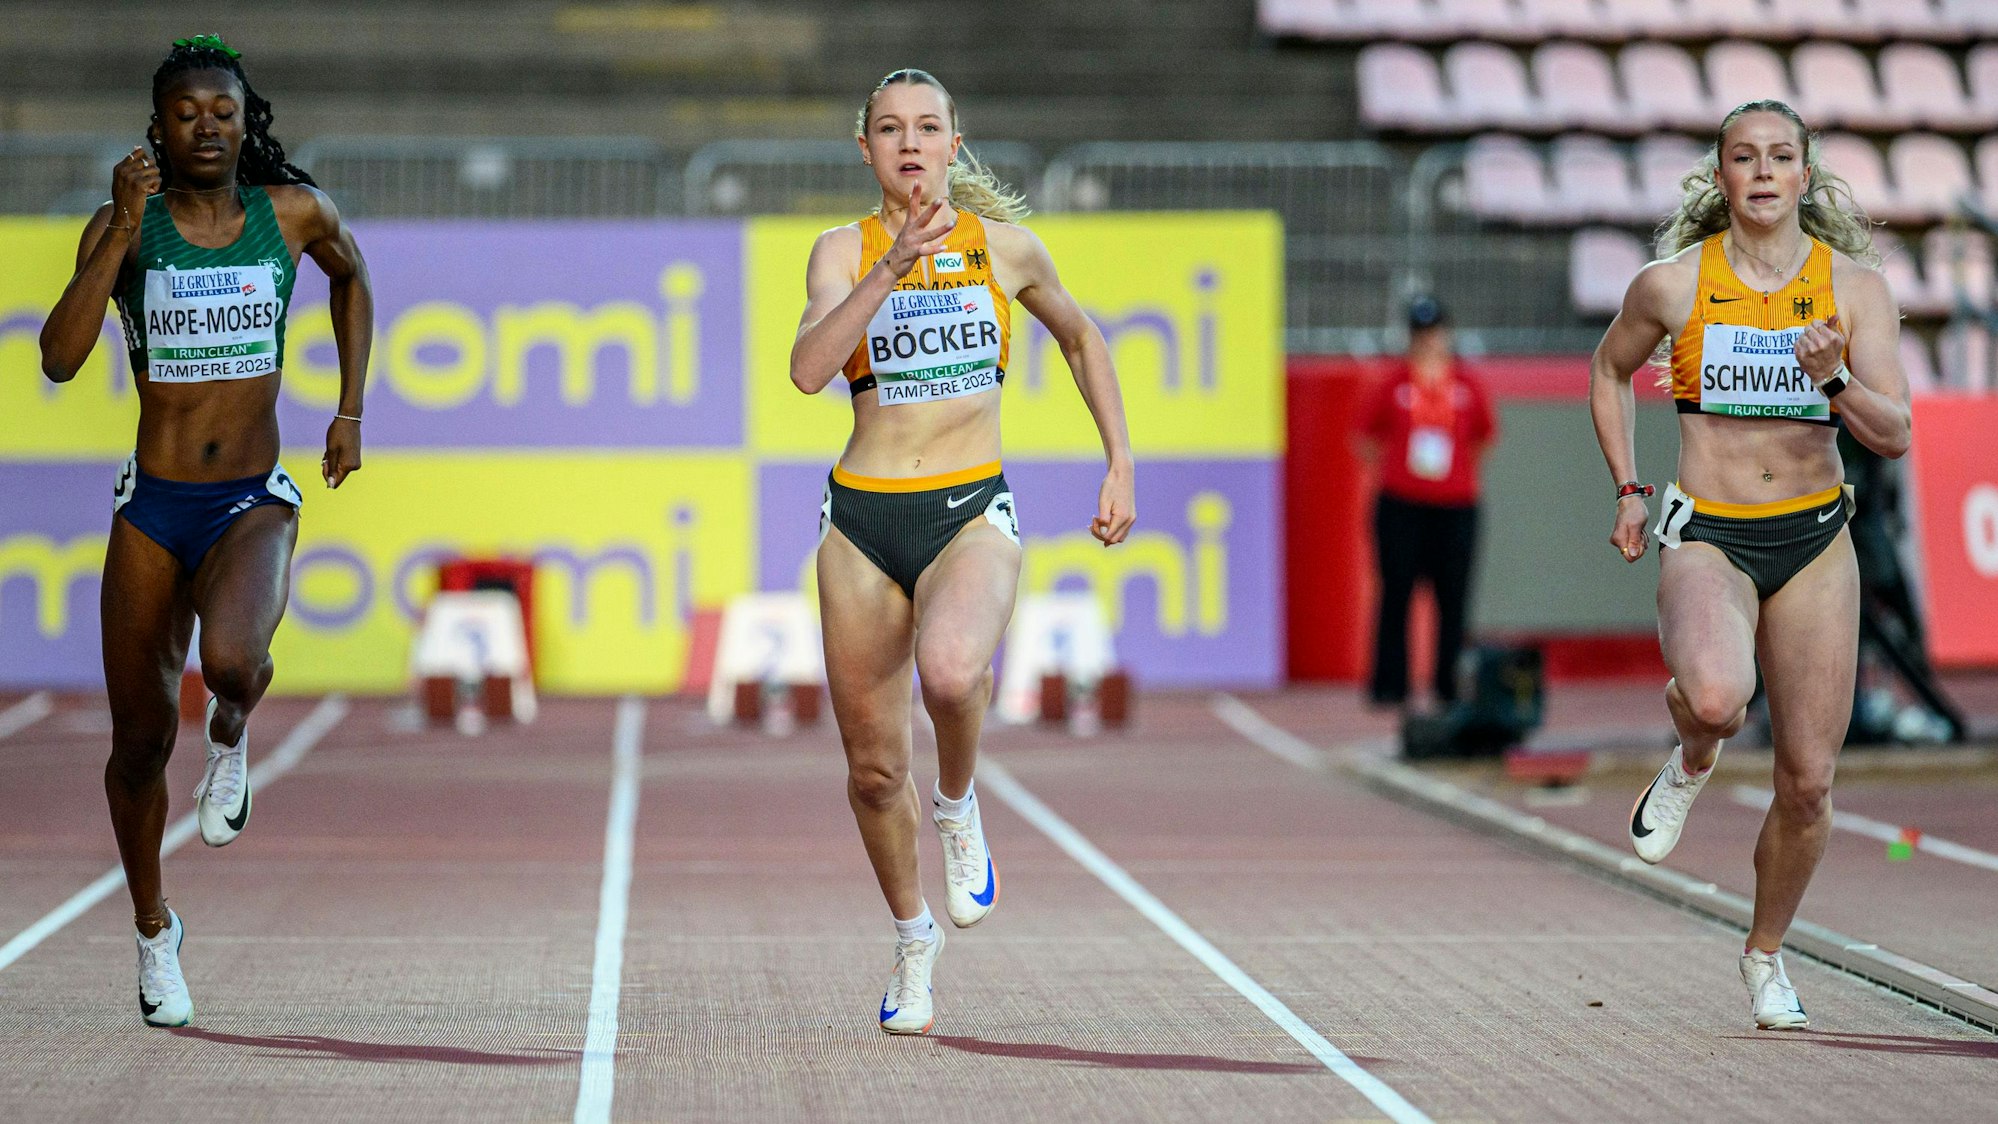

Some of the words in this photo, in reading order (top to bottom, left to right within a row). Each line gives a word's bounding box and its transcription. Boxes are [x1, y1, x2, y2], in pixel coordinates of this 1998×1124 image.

[934, 257, 963, 269] WGV
[172, 275, 185, 290] LE
[175, 287, 238, 298] SWITZERLAND
[891, 296, 907, 312] LE
[149, 302, 273, 336] AKPE-MOSES
[896, 306, 960, 319] SWITZERLAND
[871, 320, 998, 363] BÖCKER
[1733, 331, 1748, 345] LE
[179, 348, 206, 359] RUN
[1735, 346, 1796, 355] SWITZERLAN
[155, 362, 232, 378] TAMPERE
[235, 357, 271, 374] 2025
[906, 368, 933, 380] RUN
[884, 380, 961, 400] TAMPERE
[961, 371, 993, 391] 2025
[1734, 405, 1761, 416] RUN
